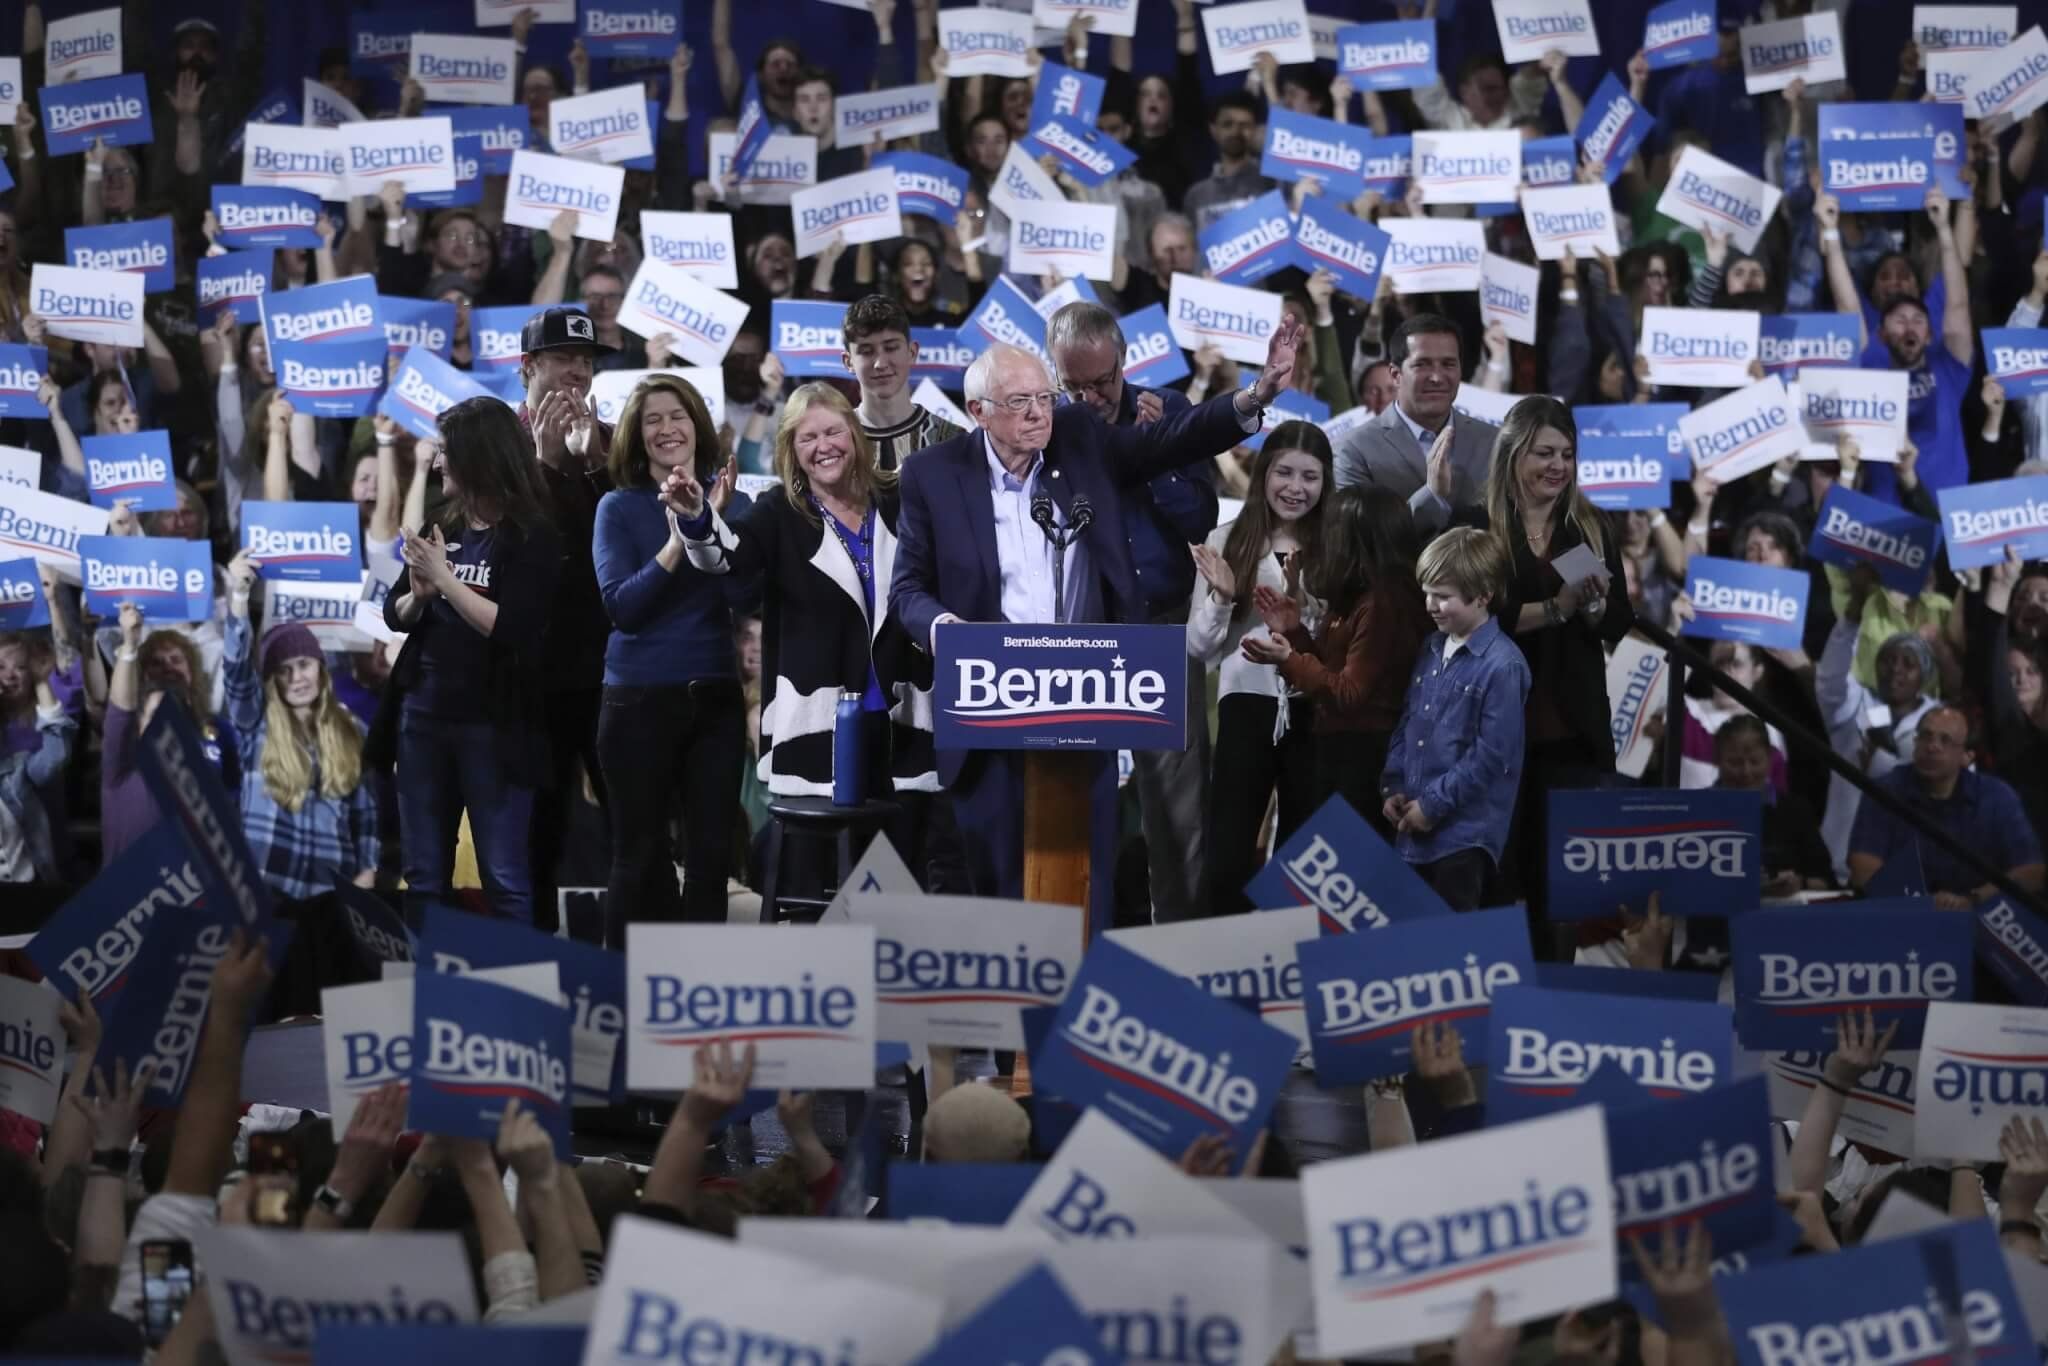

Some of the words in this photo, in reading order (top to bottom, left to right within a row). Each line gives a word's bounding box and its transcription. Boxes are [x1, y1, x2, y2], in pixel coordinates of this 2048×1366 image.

[586, 9, 676, 34] Bernie
[1216, 20, 1300, 48] Bernie
[1506, 12, 1588, 37] Bernie
[1921, 25, 2009, 48] Bernie
[50, 30, 115, 61] Bernie
[947, 29, 1026, 54] Bernie
[1343, 38, 1430, 68] Bernie
[1749, 36, 1833, 69] Bernie
[420, 54, 507, 80] Bernie
[48, 95, 142, 130] Bernie
[558, 110, 640, 142] Bernie
[843, 98, 932, 126] Bernie
[481, 123, 523, 148] nie
[1034, 121, 1115, 176] Bernie
[1270, 128, 1362, 171] Bernie
[253, 146, 345, 175] Bernie
[351, 140, 444, 169] Bernie
[1421, 152, 1511, 176] Bernie
[1526, 157, 1571, 184] nie
[1829, 156, 1928, 185] Bernie
[518, 174, 610, 212] Bernie
[896, 172, 961, 206] ernie
[1677, 170, 1762, 227] Bernie
[218, 201, 317, 226] Bernie
[802, 191, 890, 231] Bernie
[1533, 208, 1607, 234] Bernie
[650, 235, 726, 261] Bernie
[1019, 221, 1105, 251] Bernie
[1206, 217, 1289, 269] Bernie
[1298, 213, 1378, 275] Bernie
[75, 242, 166, 269] Bernie
[1391, 241, 1480, 265] Bernie
[200, 269, 265, 299] Bernie
[38, 288, 134, 320] Bernie
[637, 280, 727, 342] Bernie
[1178, 296, 1270, 337] Bernie
[273, 302, 373, 340] Bernie
[1125, 331, 1170, 366] nie
[1651, 333, 1747, 358] Bernie
[1761, 332, 1853, 360] Bernie
[1994, 346, 2048, 372] Ber
[0, 363, 40, 391] nie
[283, 361, 383, 391] Bernie
[398, 366, 453, 416] Ber
[1806, 392, 1897, 421] Bernie
[1695, 406, 1786, 457] Bernie
[89, 454, 165, 488] Bernie
[247, 526, 352, 556] Bernie
[1822, 506, 1926, 569] Bernie
[87, 560, 178, 591] Bernie
[1694, 578, 1798, 623] Bernie
[1003, 636, 1119, 649] BernieSanders.com
[955, 654, 1166, 711] Bernie
[1563, 836, 1748, 883] Bernie
[1288, 835, 1390, 933] Ber
[875, 941, 1066, 995] Bernie
[1760, 949, 1957, 998] Bernie
[645, 974, 857, 1028] Bernie
[1318, 954, 1520, 1030] Bernie
[0, 1018, 55, 1072] nie
[424, 1020, 567, 1101] Bernie
[1069, 985, 1256, 1123] Bernie
[1335, 1181, 1592, 1277] Bernie
